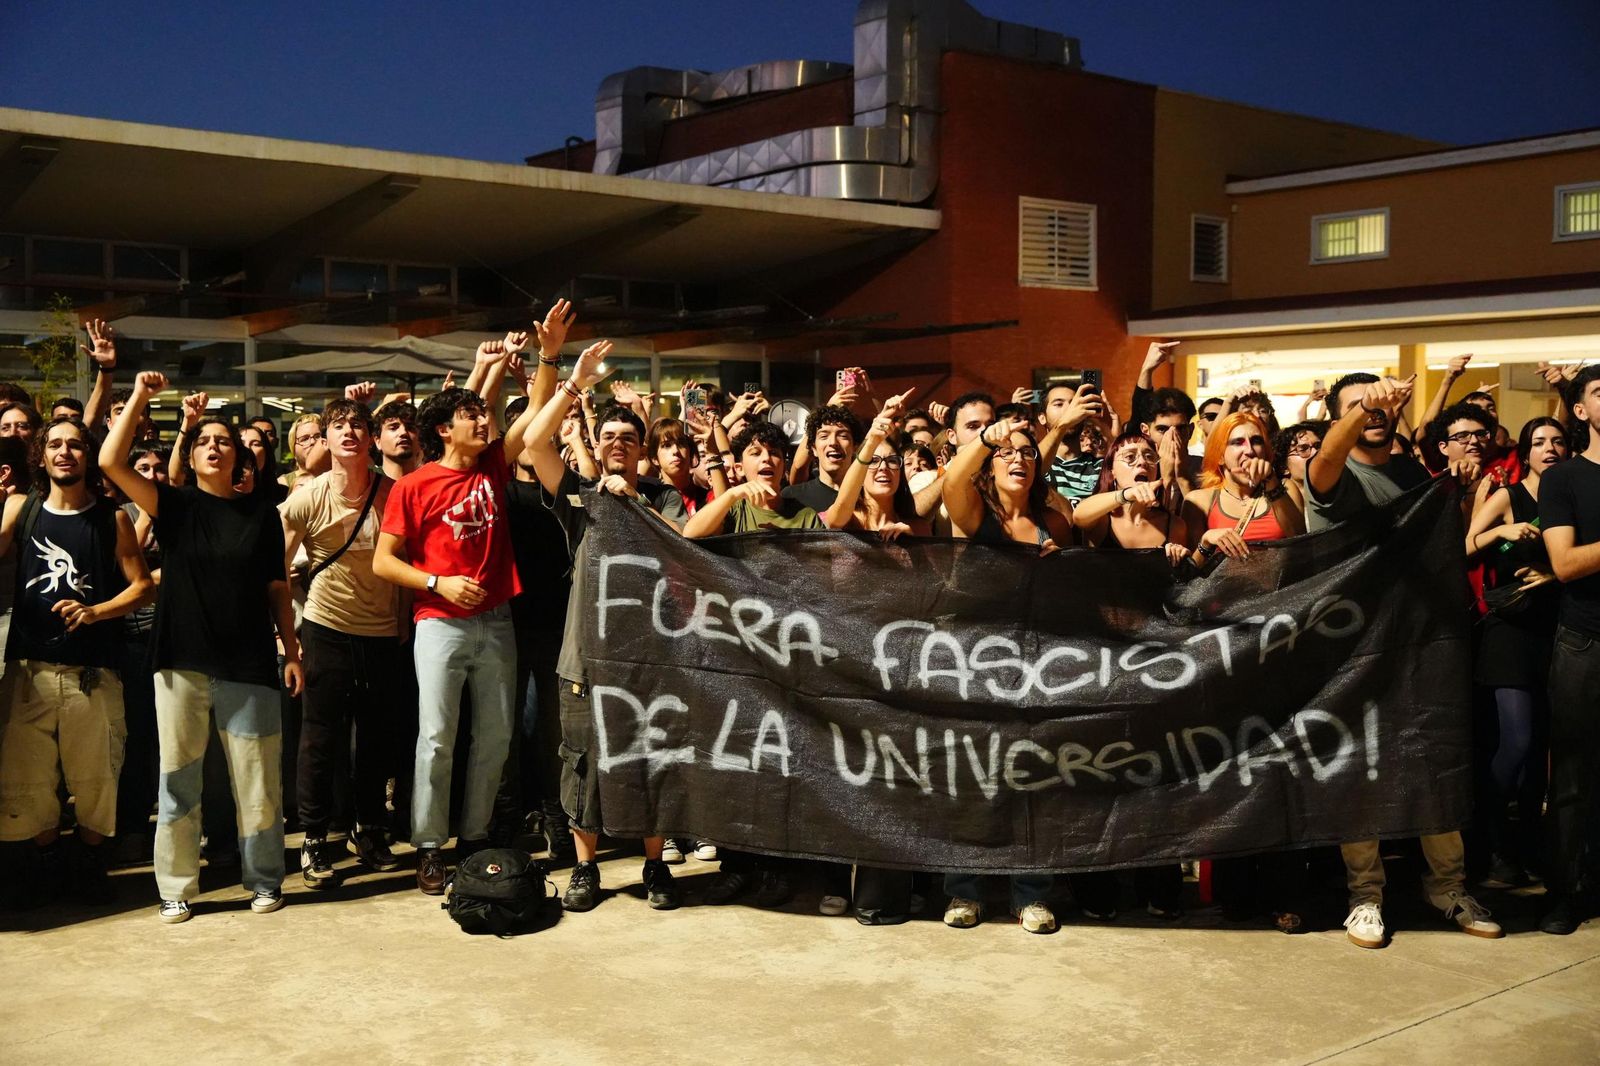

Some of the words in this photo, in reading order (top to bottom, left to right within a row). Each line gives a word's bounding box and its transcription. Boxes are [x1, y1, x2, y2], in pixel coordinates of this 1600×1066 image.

[596, 553, 839, 667] FUERA
[872, 593, 1366, 701] FASCISTAS
[592, 684, 696, 774] DE
[711, 699, 793, 777] LA
[829, 700, 1379, 799] UNIVERSIDAD!
